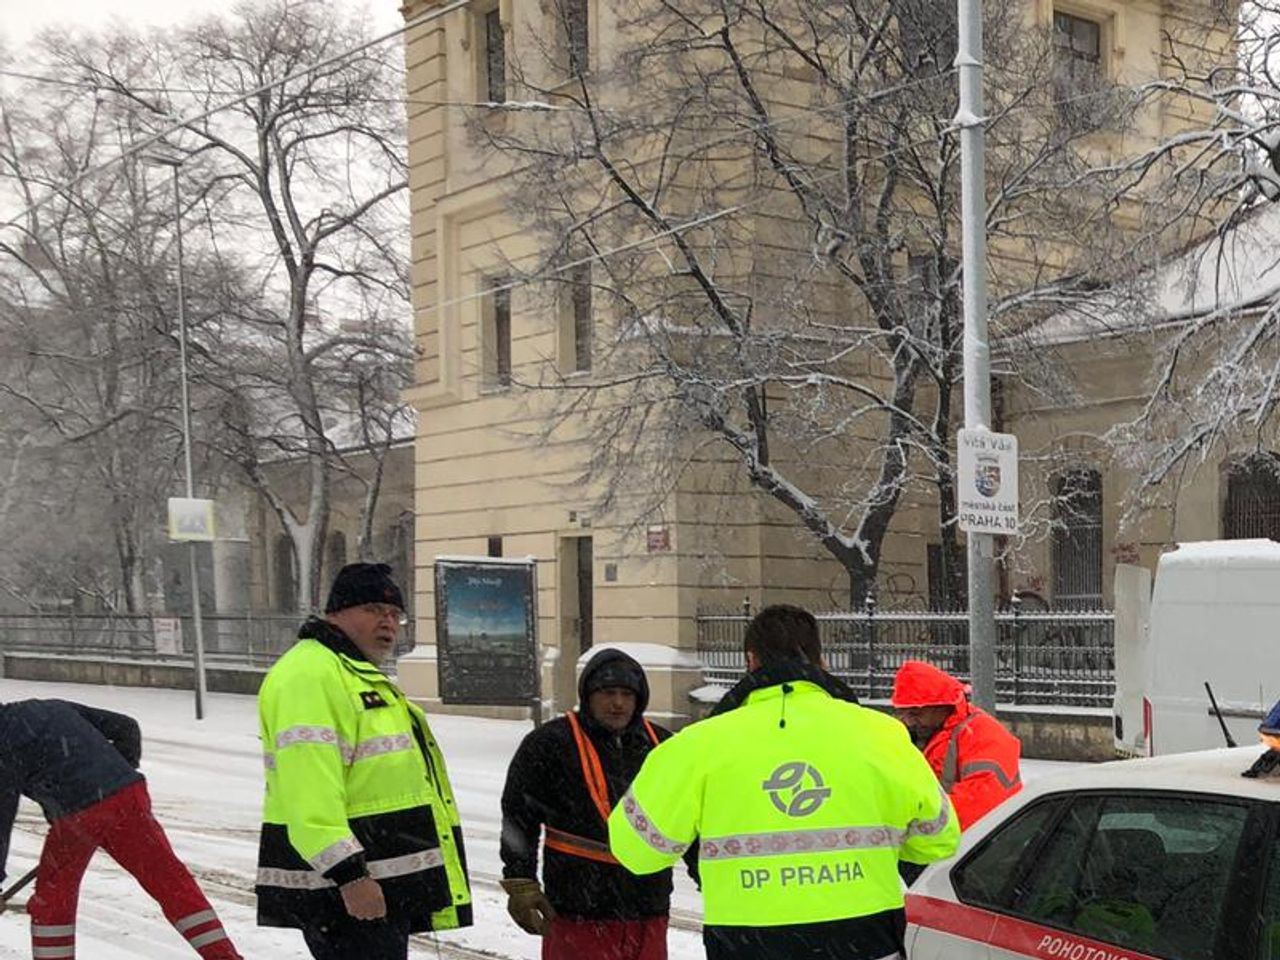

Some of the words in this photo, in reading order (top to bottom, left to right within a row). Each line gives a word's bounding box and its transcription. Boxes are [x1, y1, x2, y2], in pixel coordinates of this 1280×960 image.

[960, 513, 1002, 528] PRAHA
[1004, 517, 1016, 529] 10
[740, 868, 771, 890] DP
[781, 860, 864, 886] PRAHA
